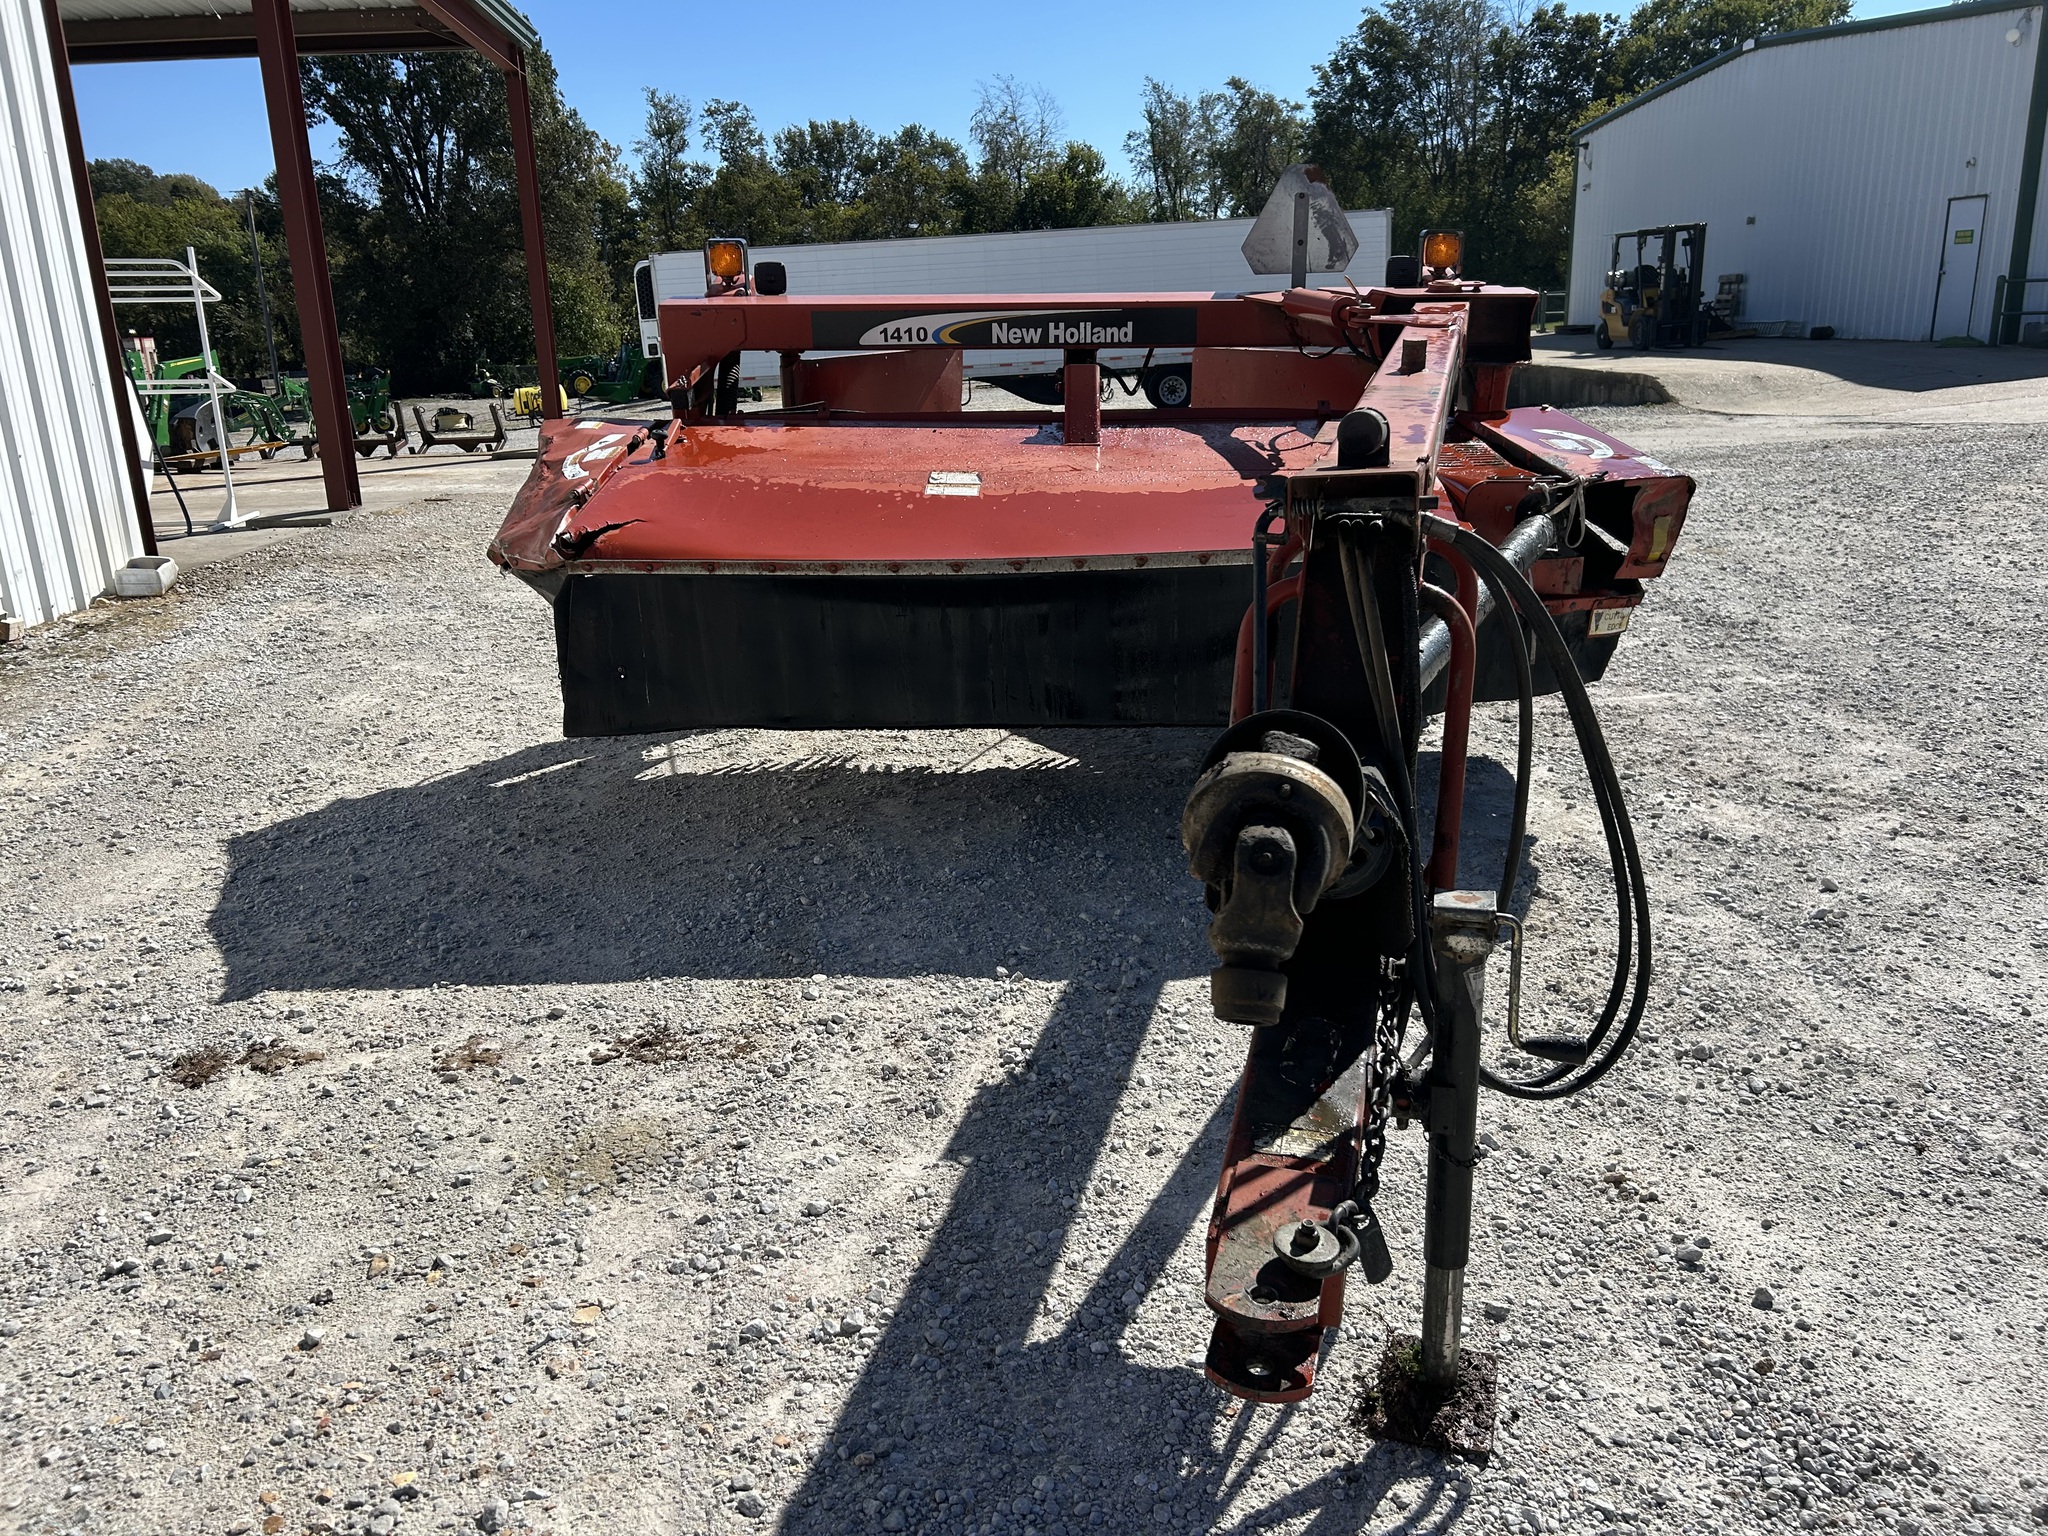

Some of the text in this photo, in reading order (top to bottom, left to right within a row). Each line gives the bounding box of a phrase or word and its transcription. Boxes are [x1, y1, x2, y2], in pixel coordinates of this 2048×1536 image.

[879, 326, 928, 343] 1410
[991, 321, 1133, 344] New Holland
